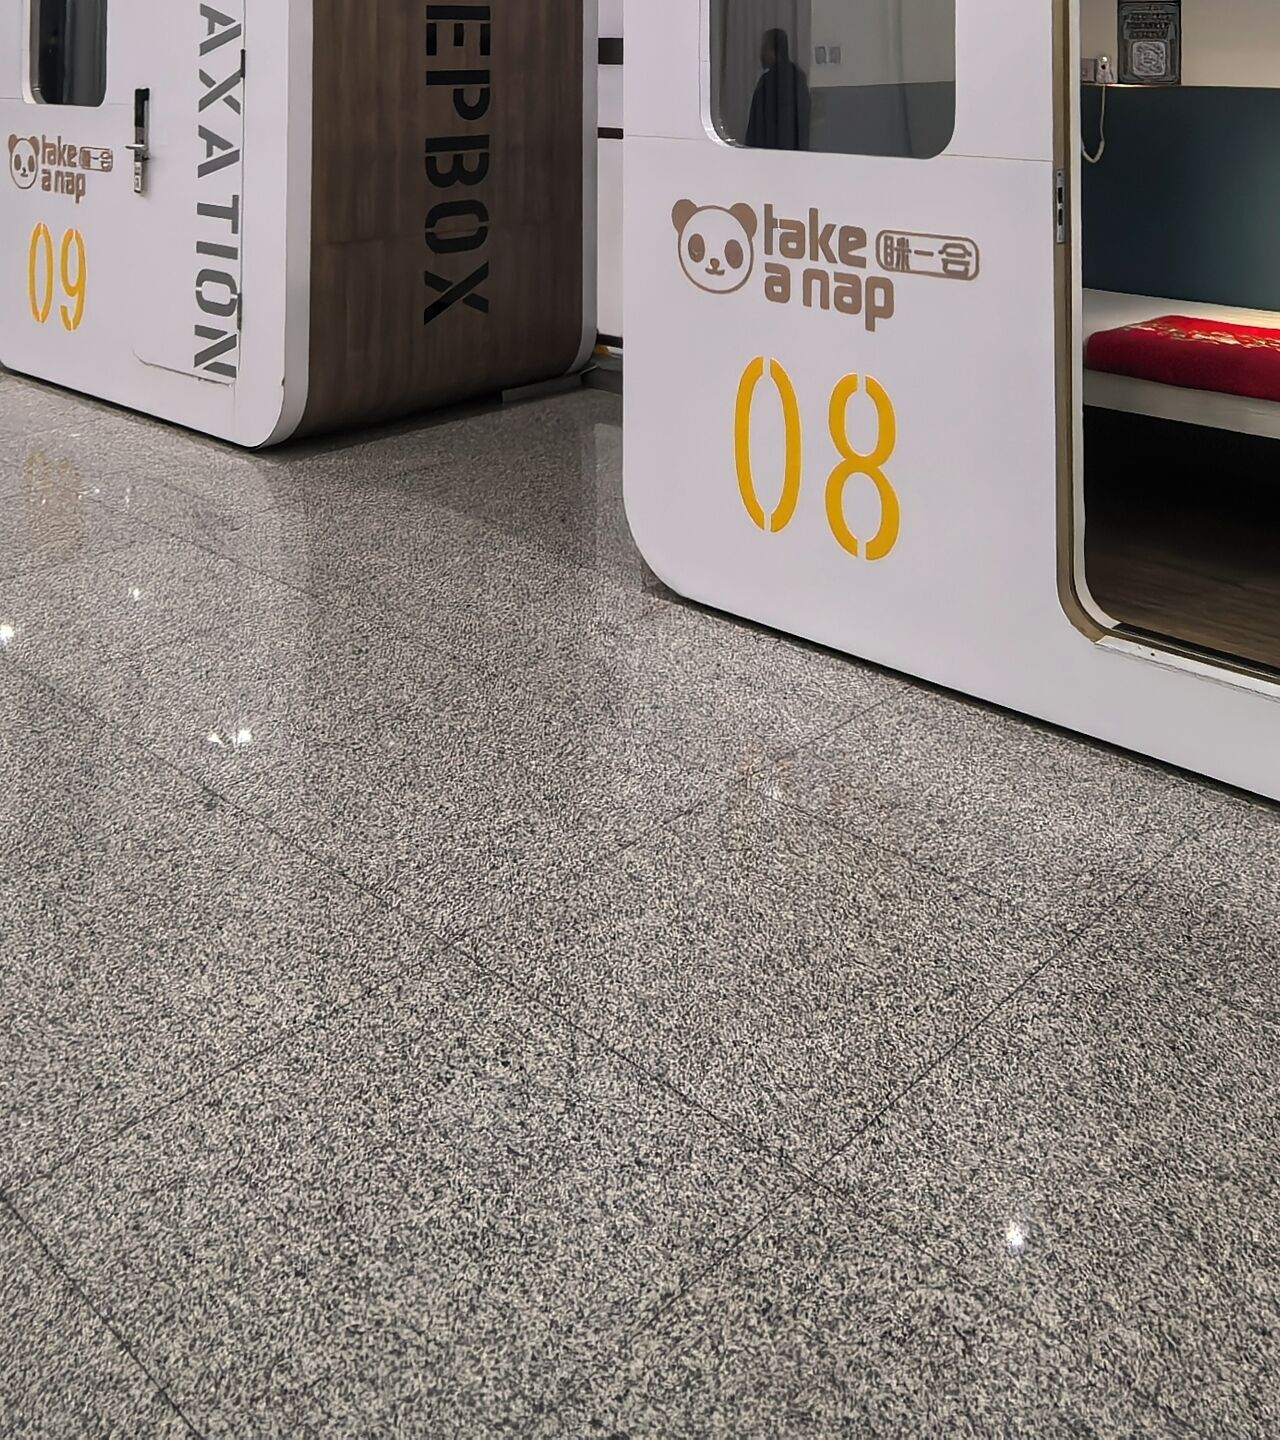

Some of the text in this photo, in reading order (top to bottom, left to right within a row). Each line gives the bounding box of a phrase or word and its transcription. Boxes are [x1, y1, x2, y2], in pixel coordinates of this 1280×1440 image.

[41, 134, 77, 169] take
[41, 168, 86, 205] a nap
[763, 202, 868, 269] take
[28, 222, 87, 332] 09
[764, 262, 895, 333] a nap
[733, 354, 901, 561] 08
